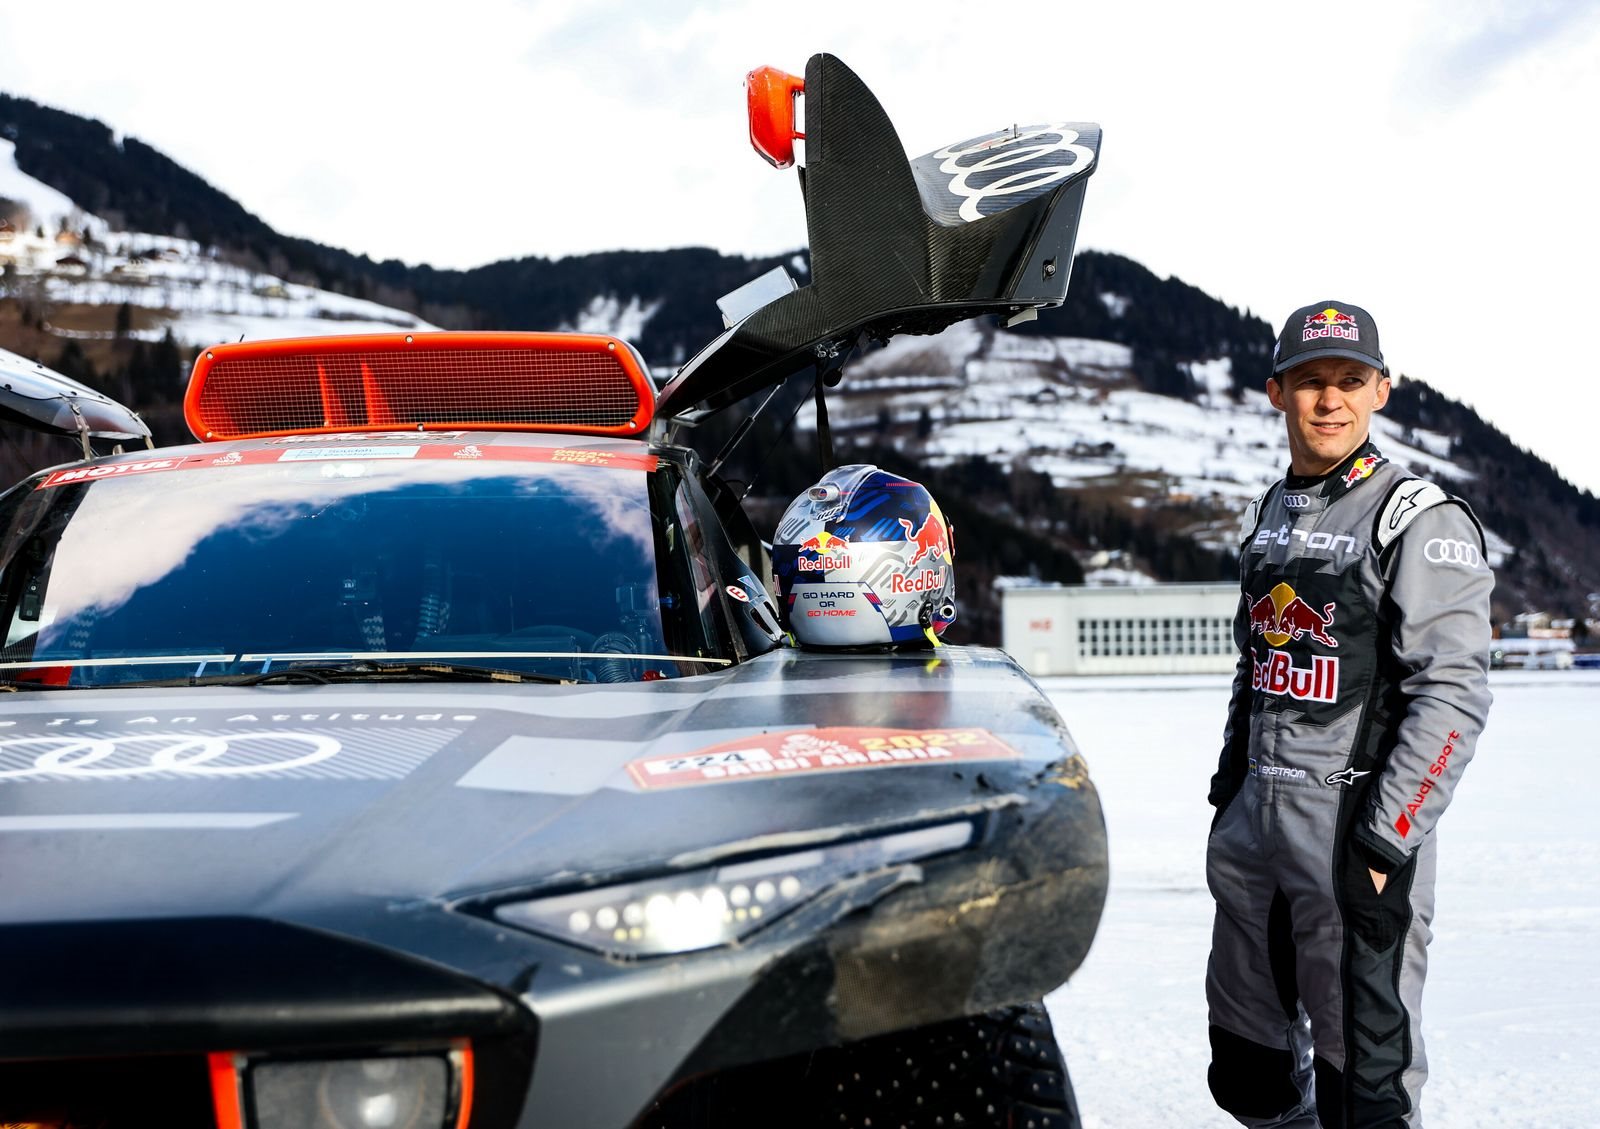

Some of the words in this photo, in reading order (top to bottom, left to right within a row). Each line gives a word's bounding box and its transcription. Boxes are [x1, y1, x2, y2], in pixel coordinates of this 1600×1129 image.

[1303, 325, 1330, 341] Red
[1331, 325, 1359, 341] Bull
[54, 458, 174, 483] MOTUL
[798, 556, 823, 571] Red
[824, 555, 850, 570] Bull
[891, 571, 926, 594] Red
[926, 567, 946, 590] Bull
[802, 591, 818, 599] GO
[821, 591, 856, 599] HARD
[819, 600, 836, 608] OR
[823, 609, 857, 617] HOME
[1268, 651, 1338, 702] Bull
[226, 713, 477, 722] Attitude
[858, 732, 986, 751] 2022
[665, 752, 746, 771] 224
[701, 757, 812, 779] SAUDI
[820, 746, 953, 767] ARABIA
[1407, 777, 1436, 817] Audi
[1428, 730, 1460, 777] Sport
